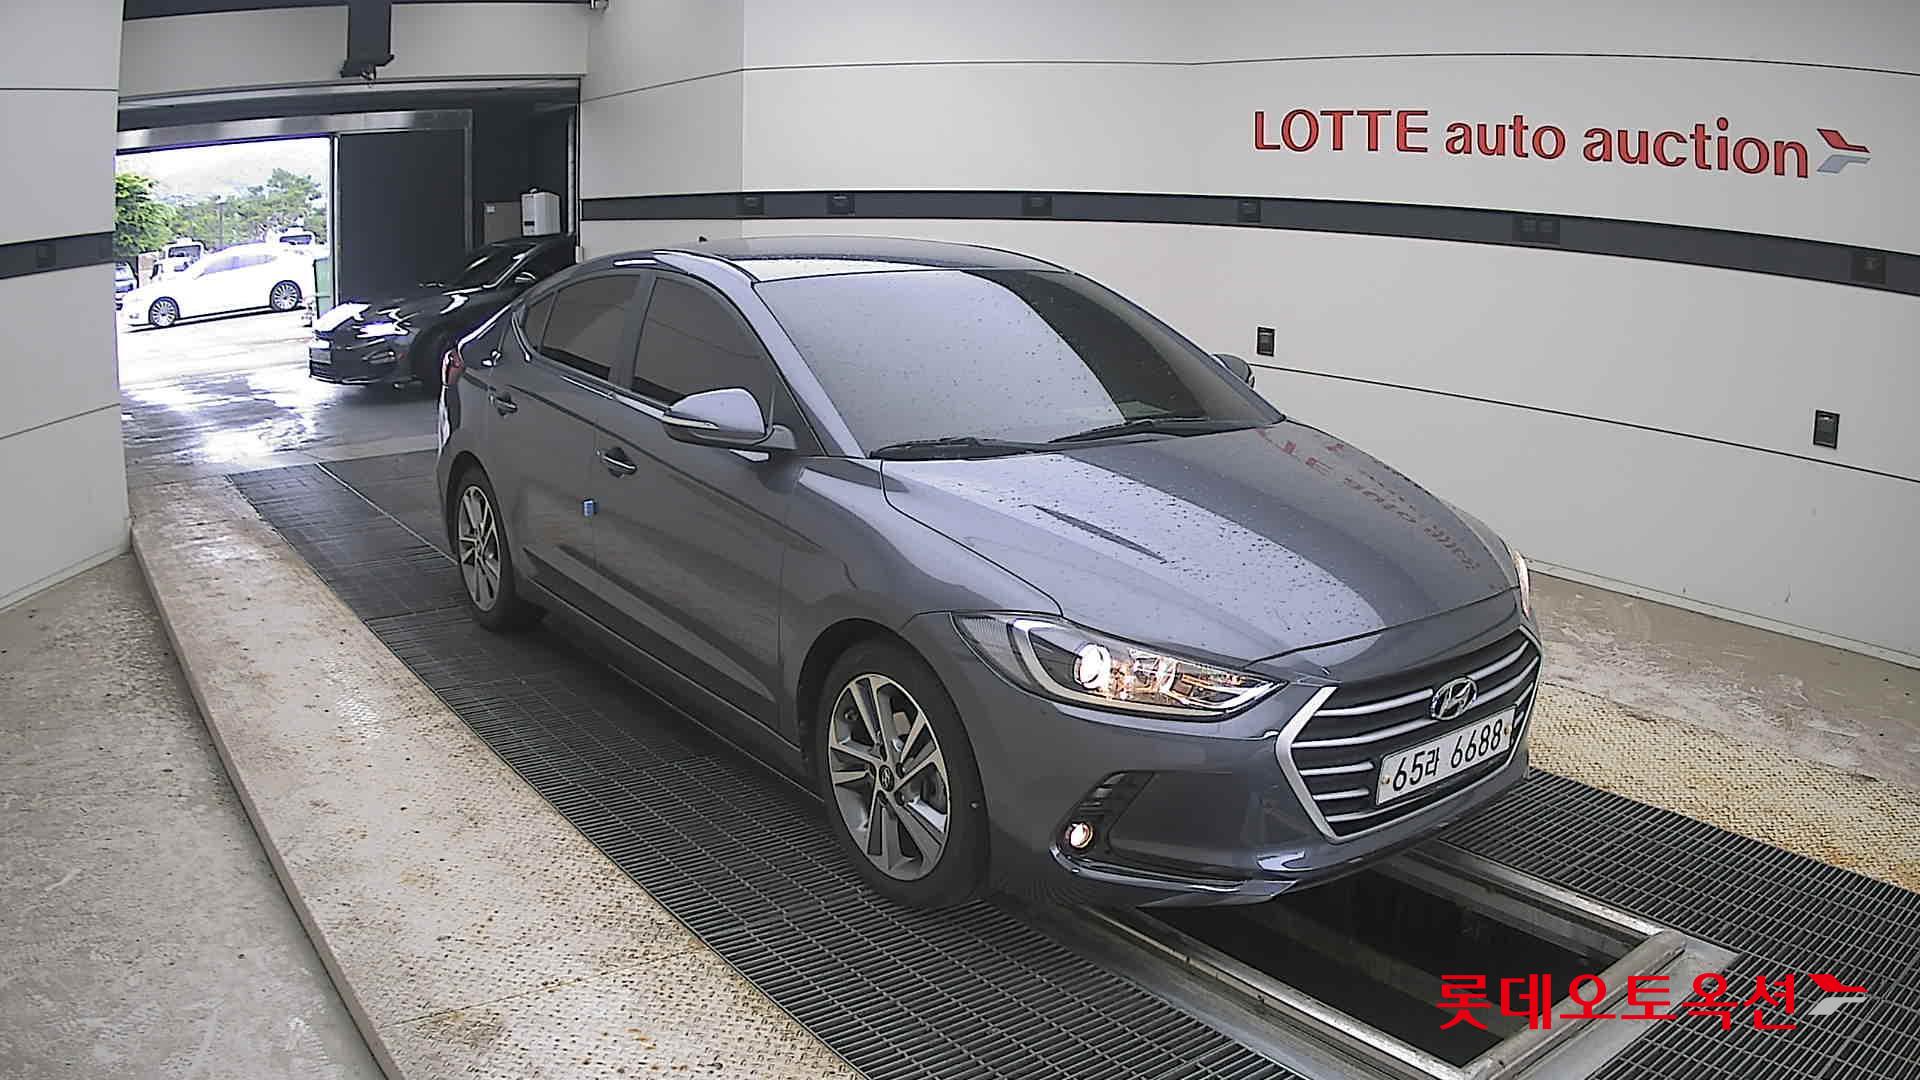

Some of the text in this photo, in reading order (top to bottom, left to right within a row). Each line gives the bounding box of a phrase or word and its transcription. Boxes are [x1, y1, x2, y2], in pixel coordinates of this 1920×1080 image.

[1254, 109, 1809, 178] LOTTE auto auction
[1393, 719, 1503, 791] 65라 6688
